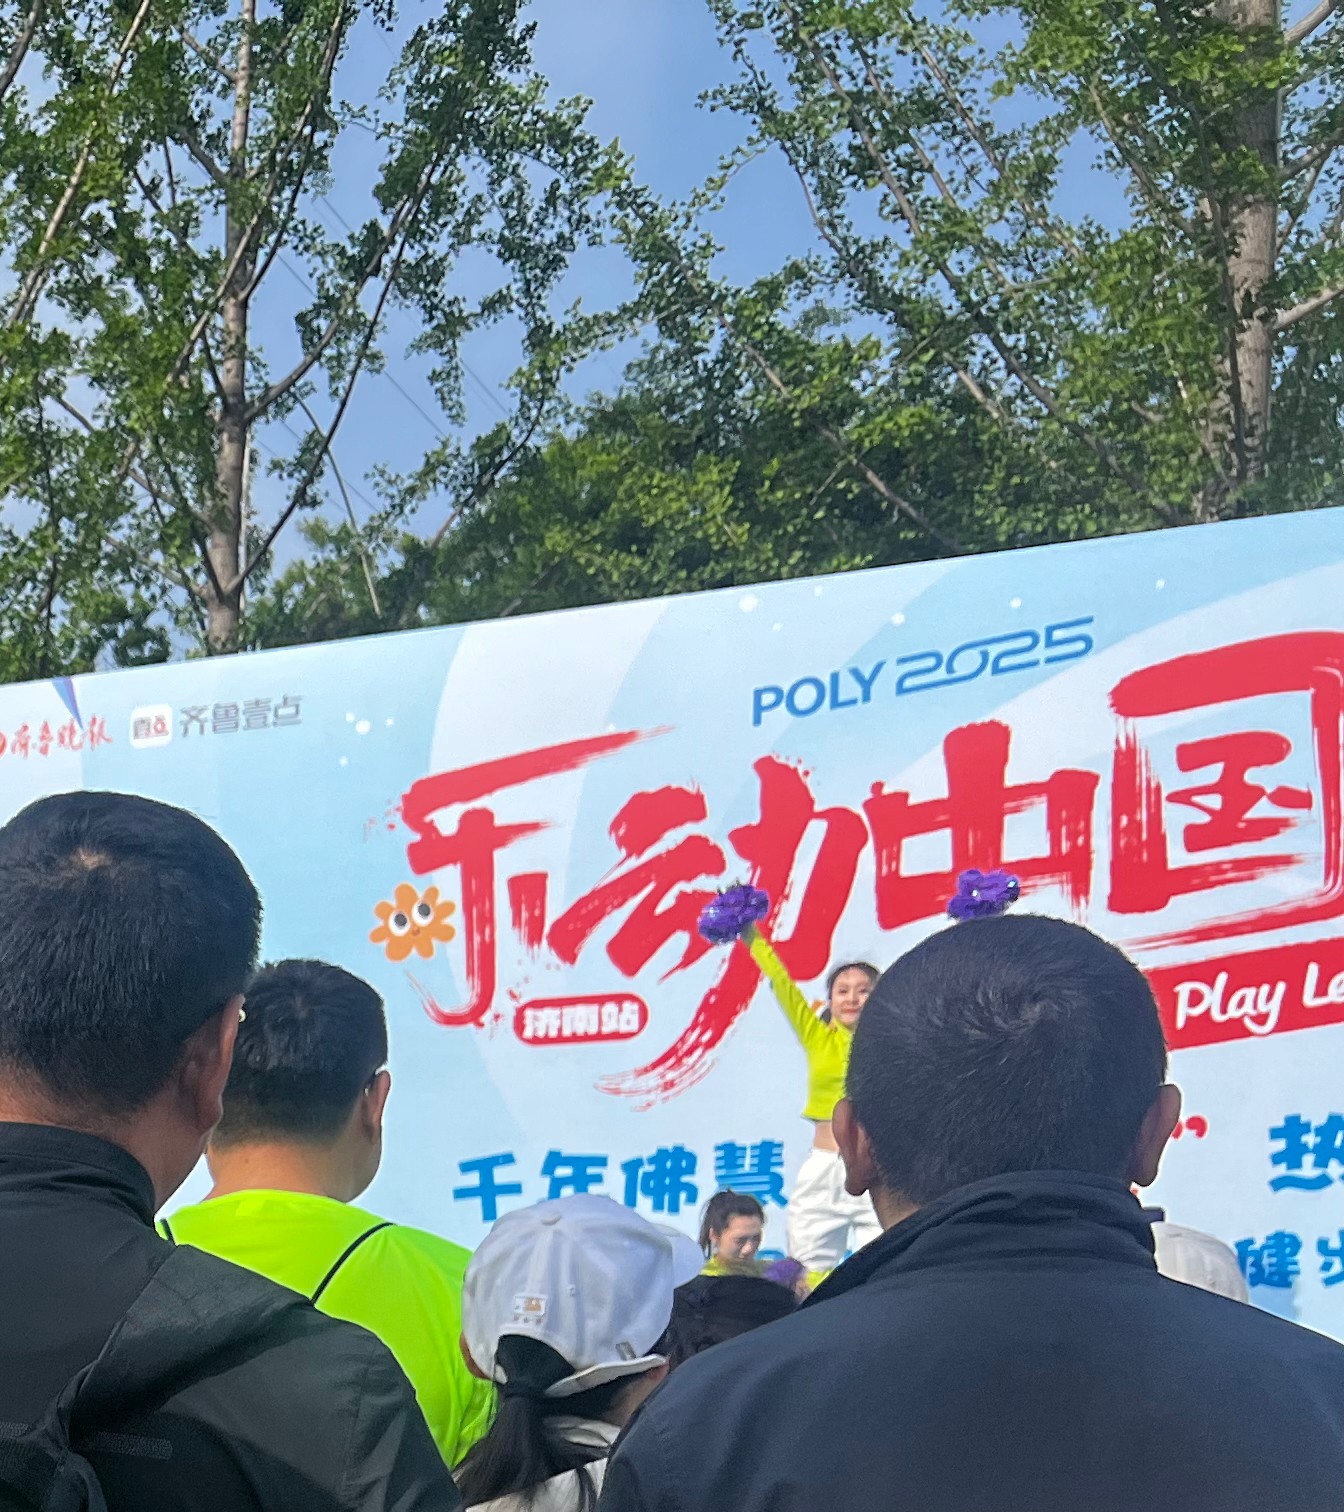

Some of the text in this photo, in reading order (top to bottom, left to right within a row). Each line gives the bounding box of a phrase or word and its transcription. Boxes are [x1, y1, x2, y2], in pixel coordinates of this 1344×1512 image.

[752, 615, 1095, 726] POLY 2025
[179, 695, 304, 739] 齐鲁壹点
[522, 1002, 639, 1038] 济南站
[1173, 971, 1288, 1036] Play
